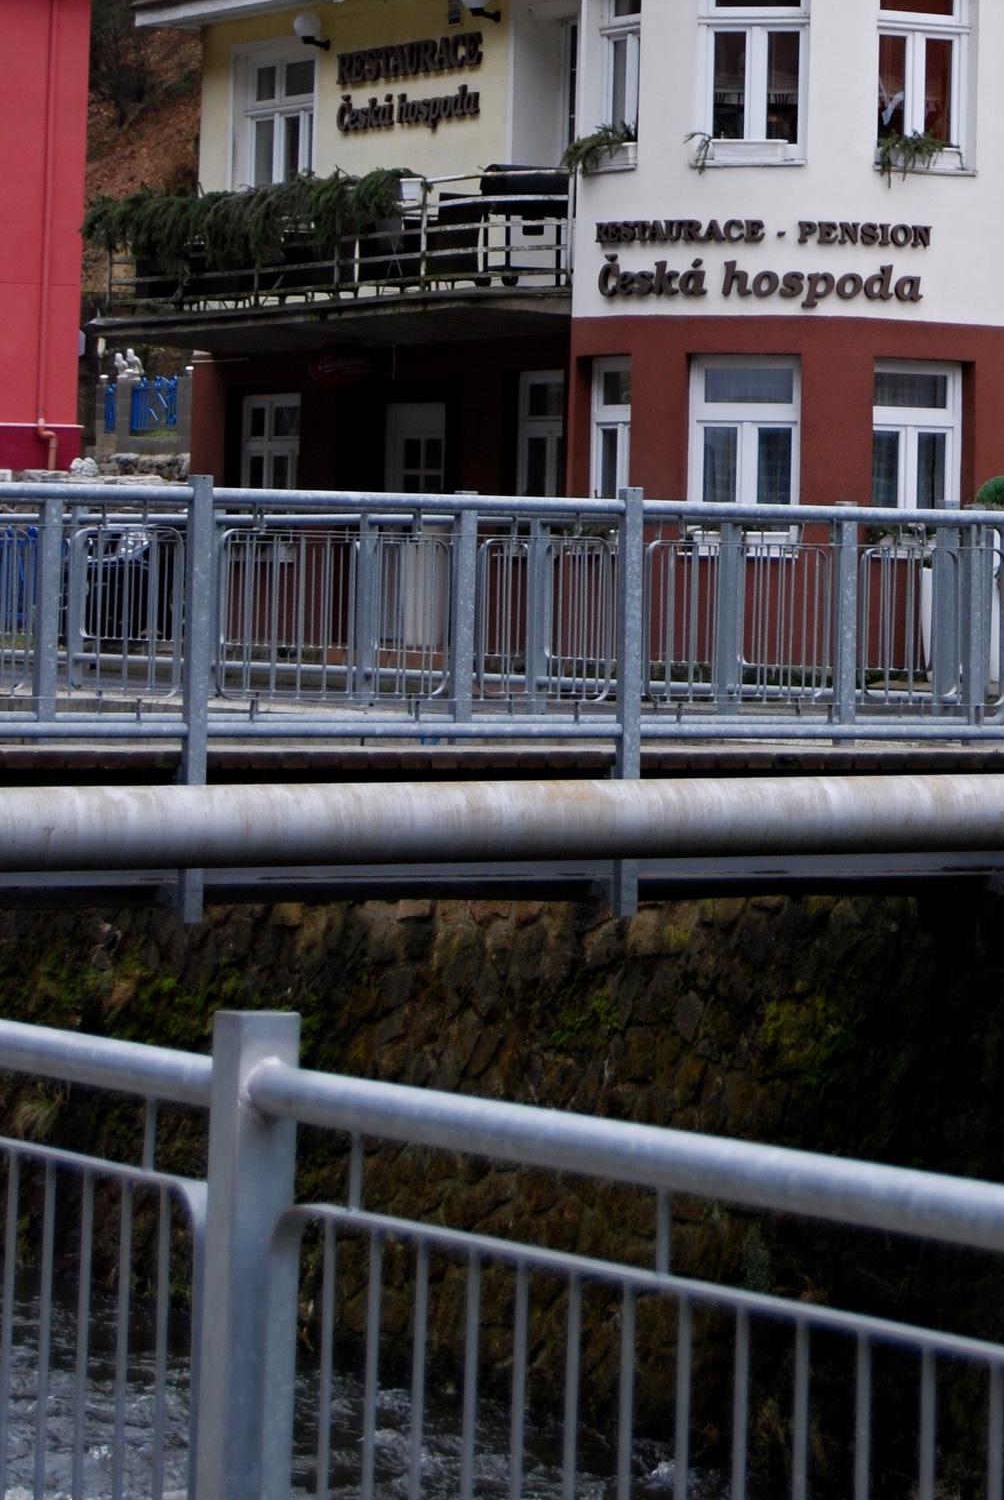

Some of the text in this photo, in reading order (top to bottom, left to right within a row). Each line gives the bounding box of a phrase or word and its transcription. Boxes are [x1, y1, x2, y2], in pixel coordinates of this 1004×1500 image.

[336, 31, 484, 85] RESTAURACE
[336, 84, 481, 133] Česká hospoda
[595, 218, 766, 245] RESTAURACE
[797, 220, 933, 248] PENSION
[598, 253, 924, 308] Česká hospoda
